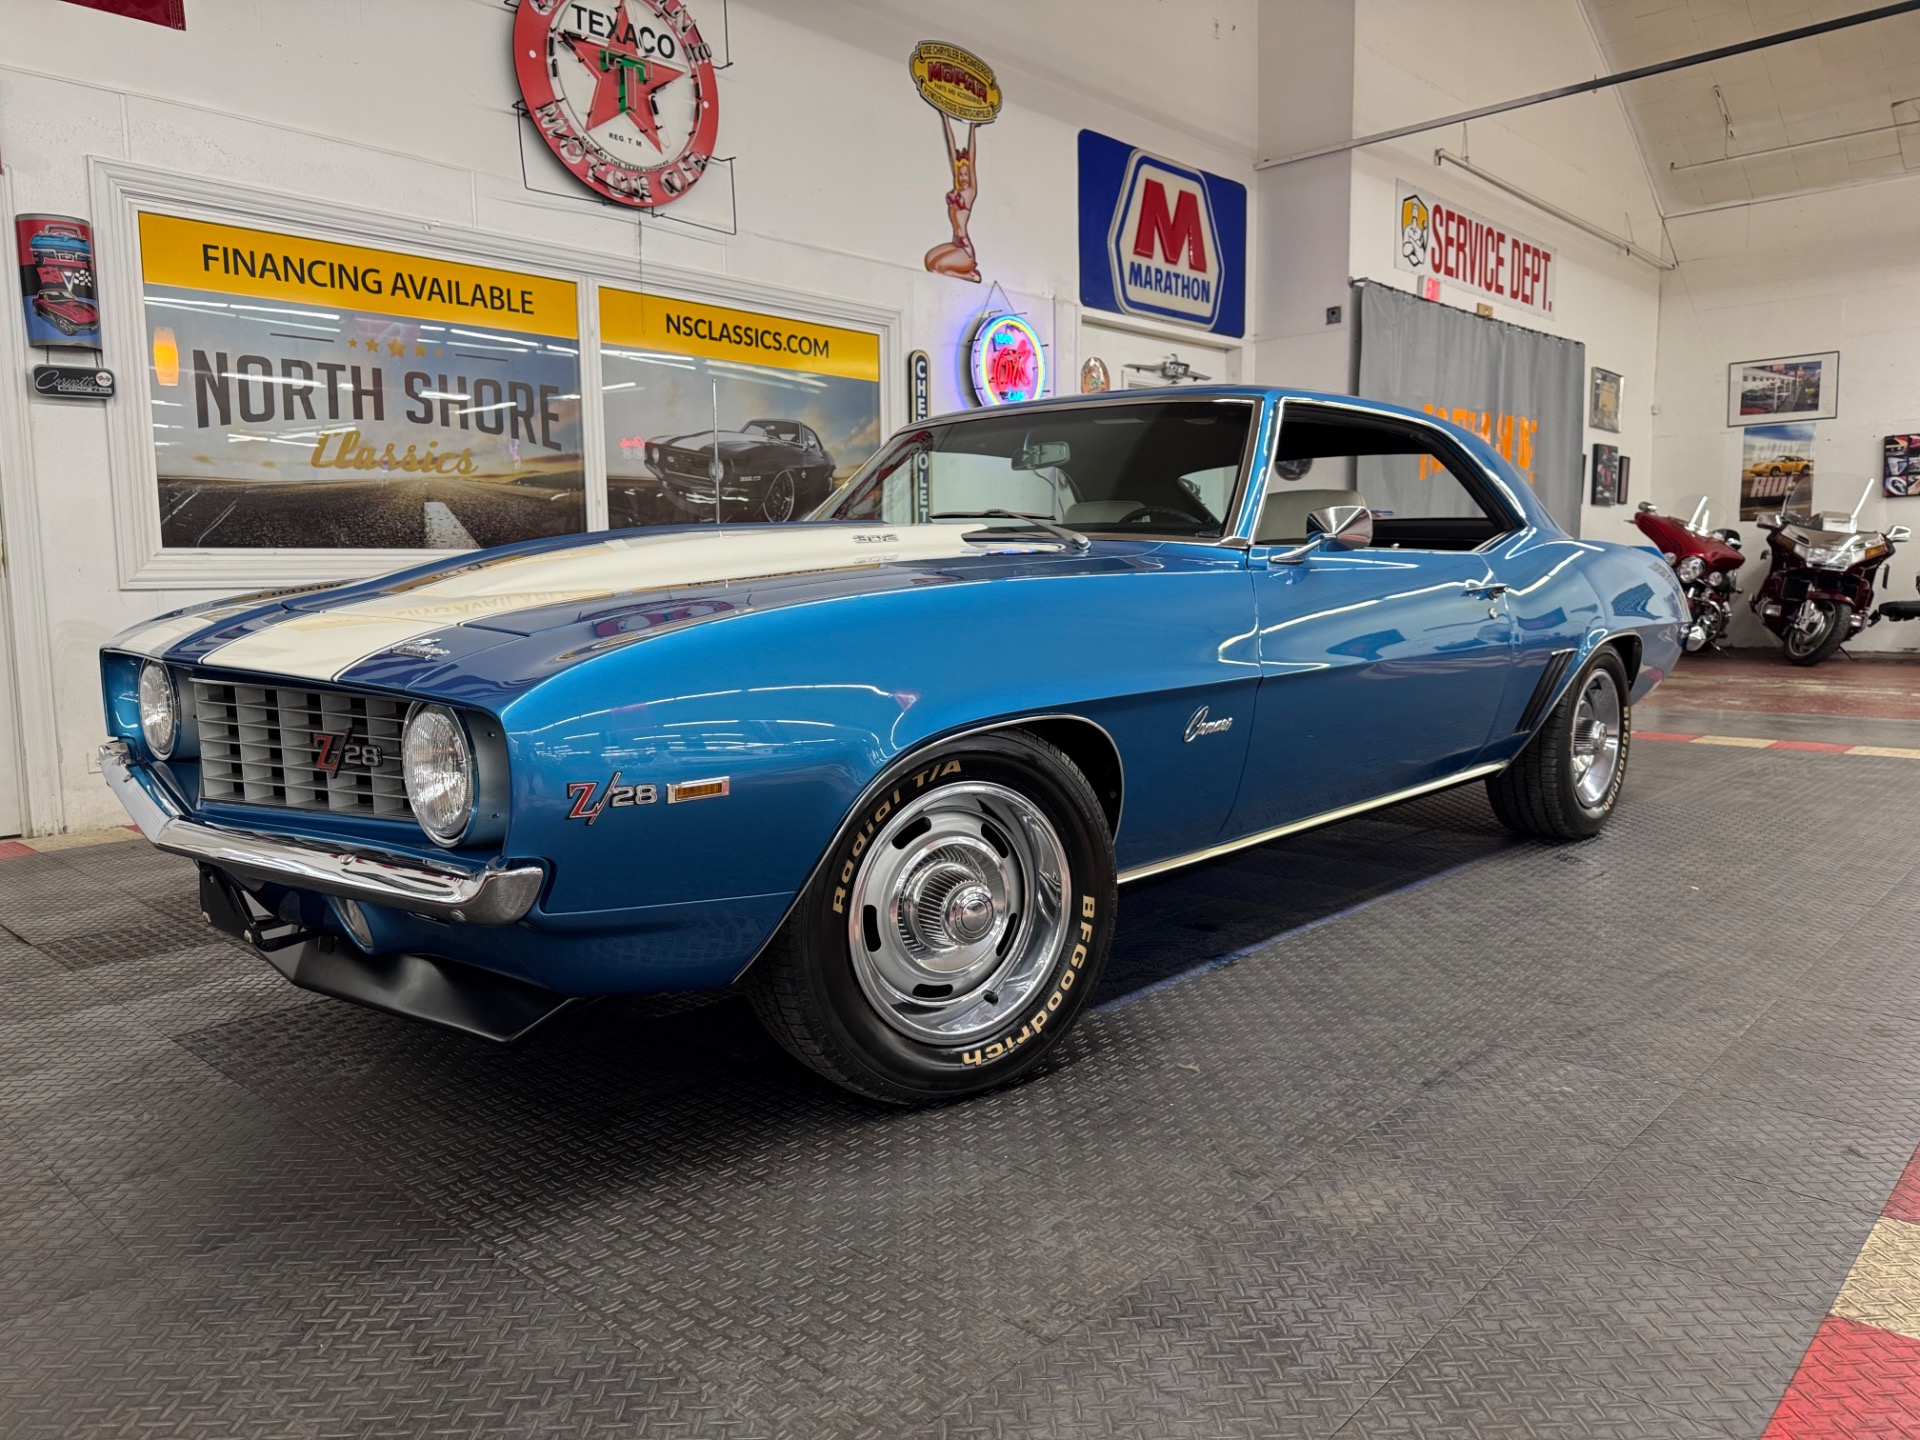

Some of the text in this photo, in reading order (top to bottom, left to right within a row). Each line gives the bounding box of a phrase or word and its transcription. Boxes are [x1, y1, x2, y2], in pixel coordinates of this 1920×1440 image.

[570, 3, 676, 59] TEXACO
[927, 61, 988, 104] MOPAR
[535, 101, 653, 203] MOTOR
[201, 243, 535, 316] FINANCING AVAILABLE
[1128, 261, 1211, 304] MARATHON
[1431, 203, 1553, 313] SERVICE DEPT.
[665, 312, 830, 359] NSCLASSICS.COM
[35, 370, 96, 390] Corvette
[192, 349, 563, 452] NORTH SHORE
[310, 431, 480, 476] Classics
[313, 727, 383, 778] Z/28
[566, 771, 658, 826] Z/28
[832, 759, 962, 915] Radial T/A
[962, 894, 1096, 1067] BFGoodrich
